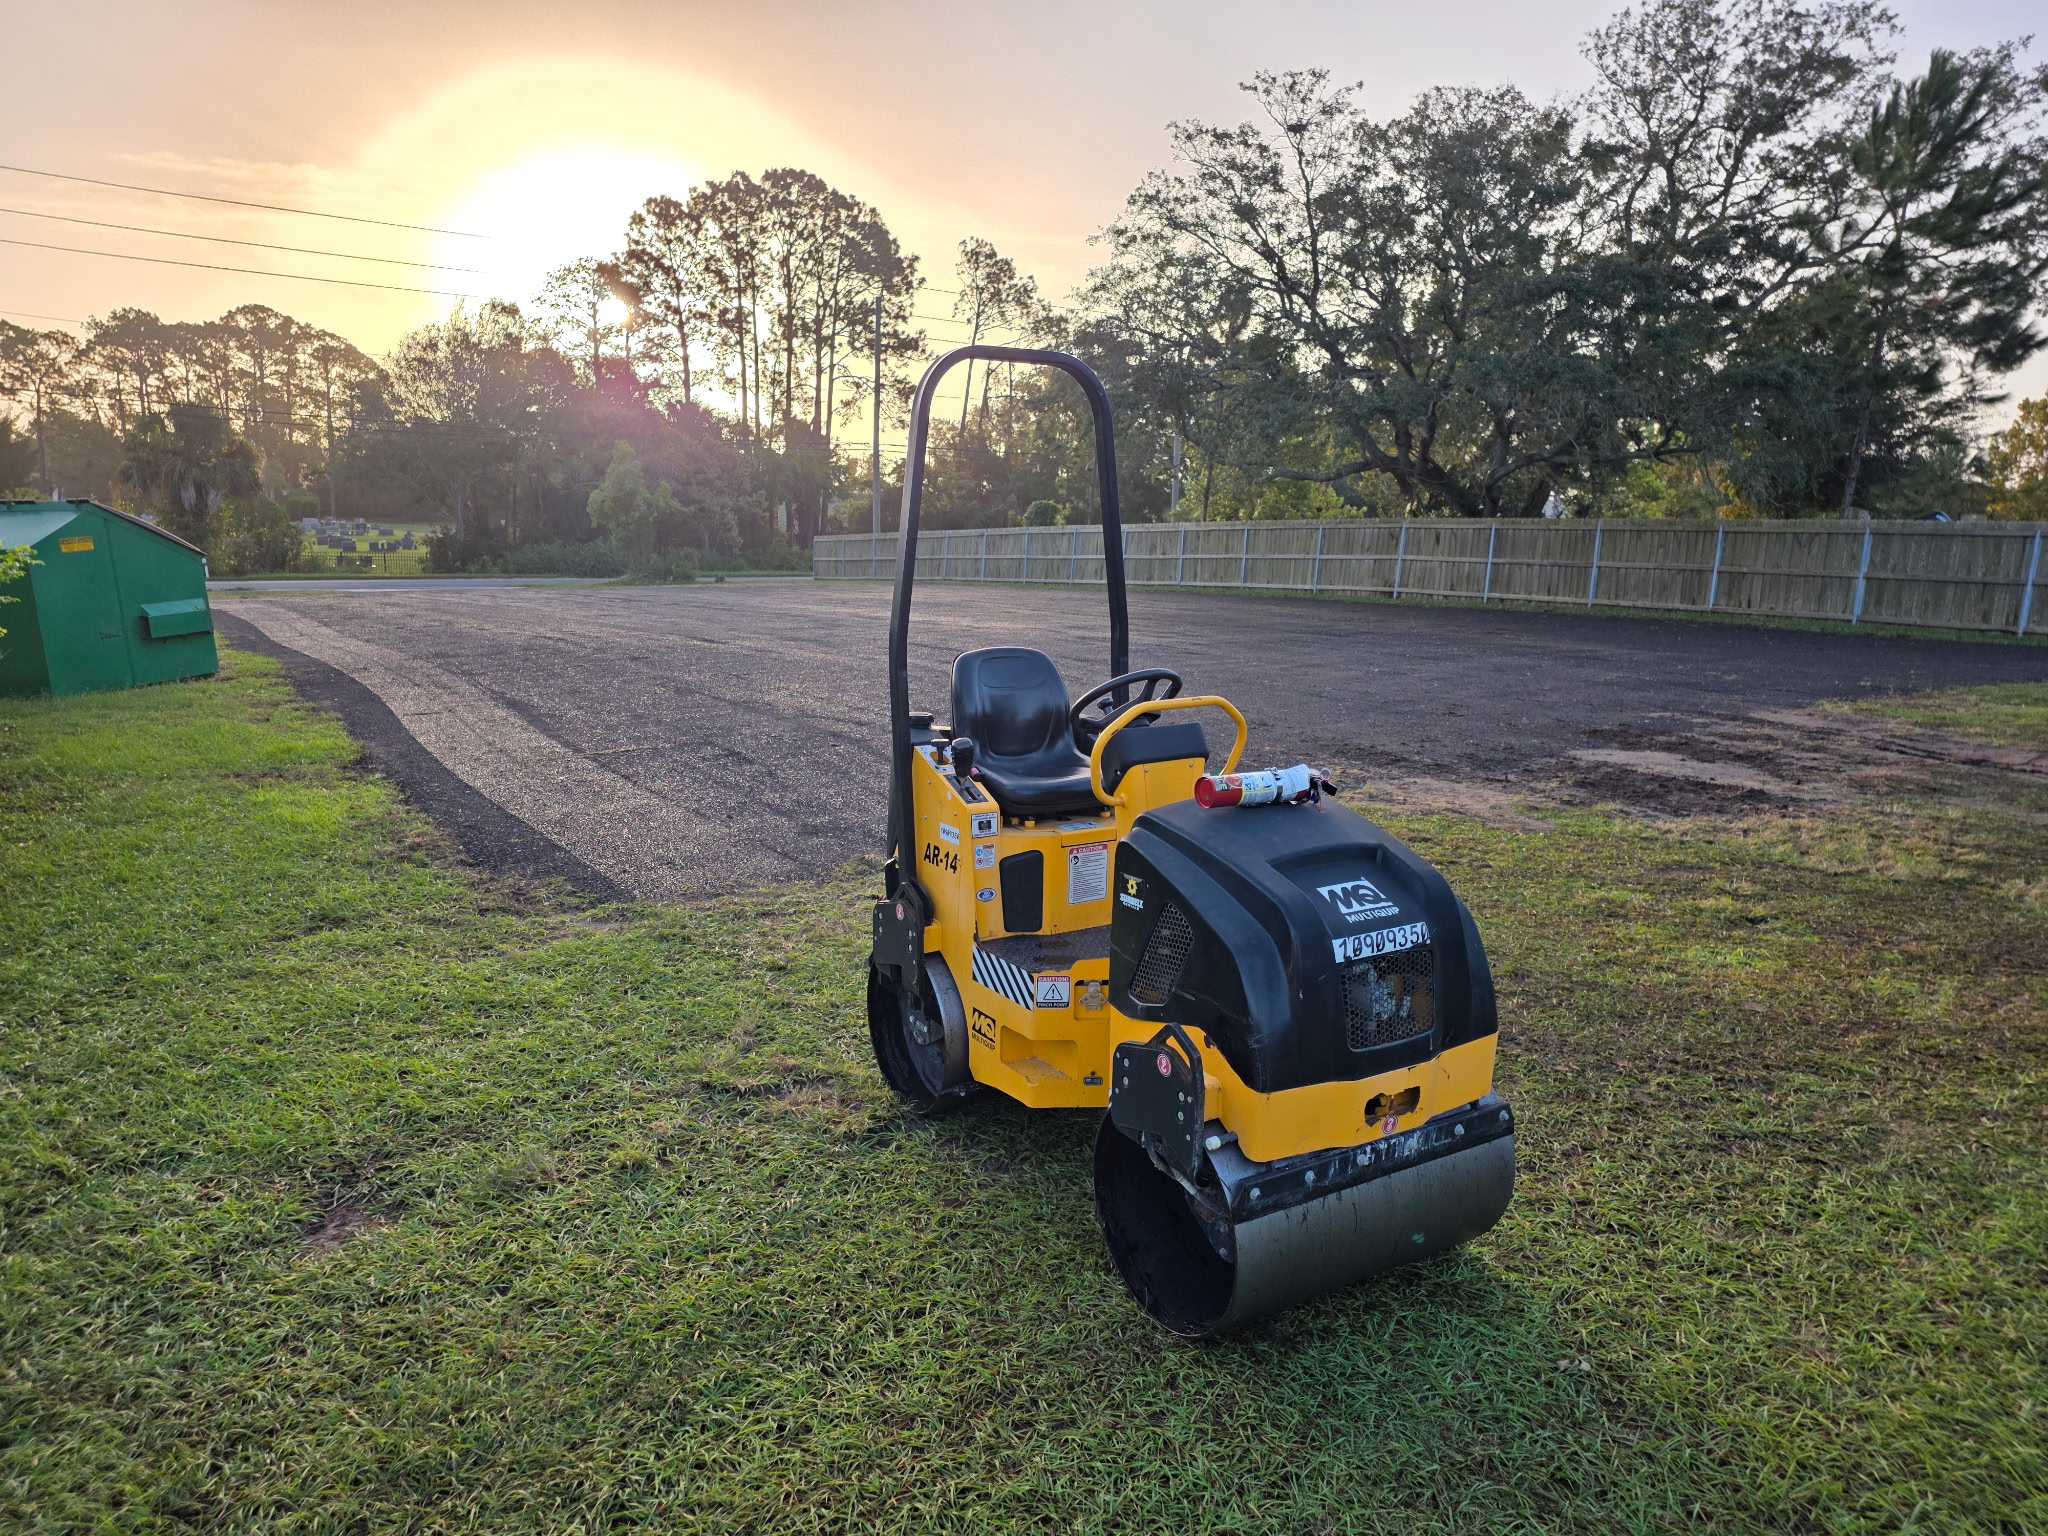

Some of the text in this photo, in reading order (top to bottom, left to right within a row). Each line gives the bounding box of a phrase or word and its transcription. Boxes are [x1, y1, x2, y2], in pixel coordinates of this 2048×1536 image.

[923, 842, 958, 874] AR-14
[1078, 845, 1103, 853] CAUTION
[1320, 880, 1395, 913] MQ
[1345, 906, 1400, 924] MULTIQUIP
[971, 1031, 996, 1051] MULTIQUIP
